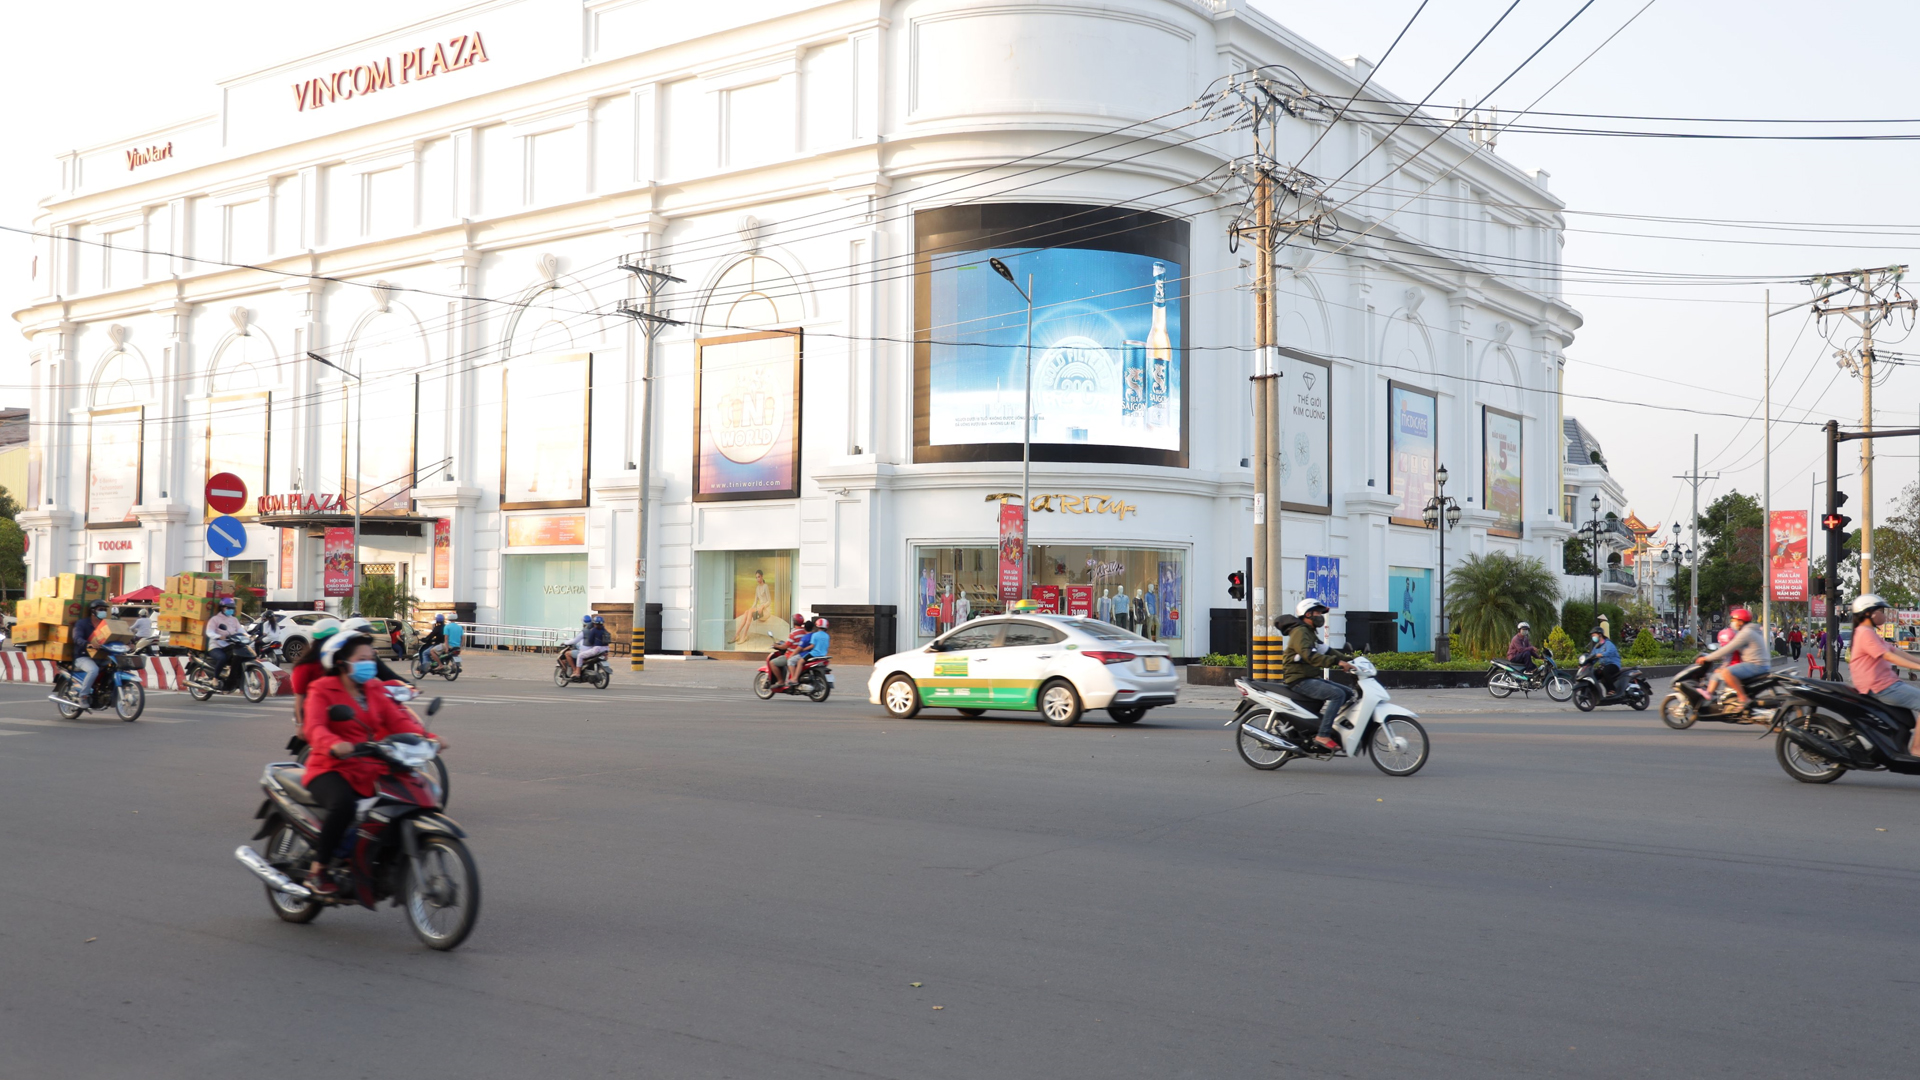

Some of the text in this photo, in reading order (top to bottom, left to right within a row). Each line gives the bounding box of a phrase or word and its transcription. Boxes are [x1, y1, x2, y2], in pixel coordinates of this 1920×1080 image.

[291, 31, 489, 112] VINCOM PLAZA
[126, 141, 173, 171] VinMart
[1043, 353, 1066, 387] COLD
[1121, 400, 1146, 411] SAIGON
[1297, 394, 1322, 408] THẾ GIỚI
[1292, 405, 1326, 421] KIM CƯƠNG
[720, 428, 773, 448] WORLD
[1499, 440, 1508, 471] 5
[710, 479, 781, 489] www.tiniworld.com
[287, 493, 350, 511] PLAZA
[98, 540, 133, 551] TOOCHA
[543, 585, 586, 594] VASCARA
